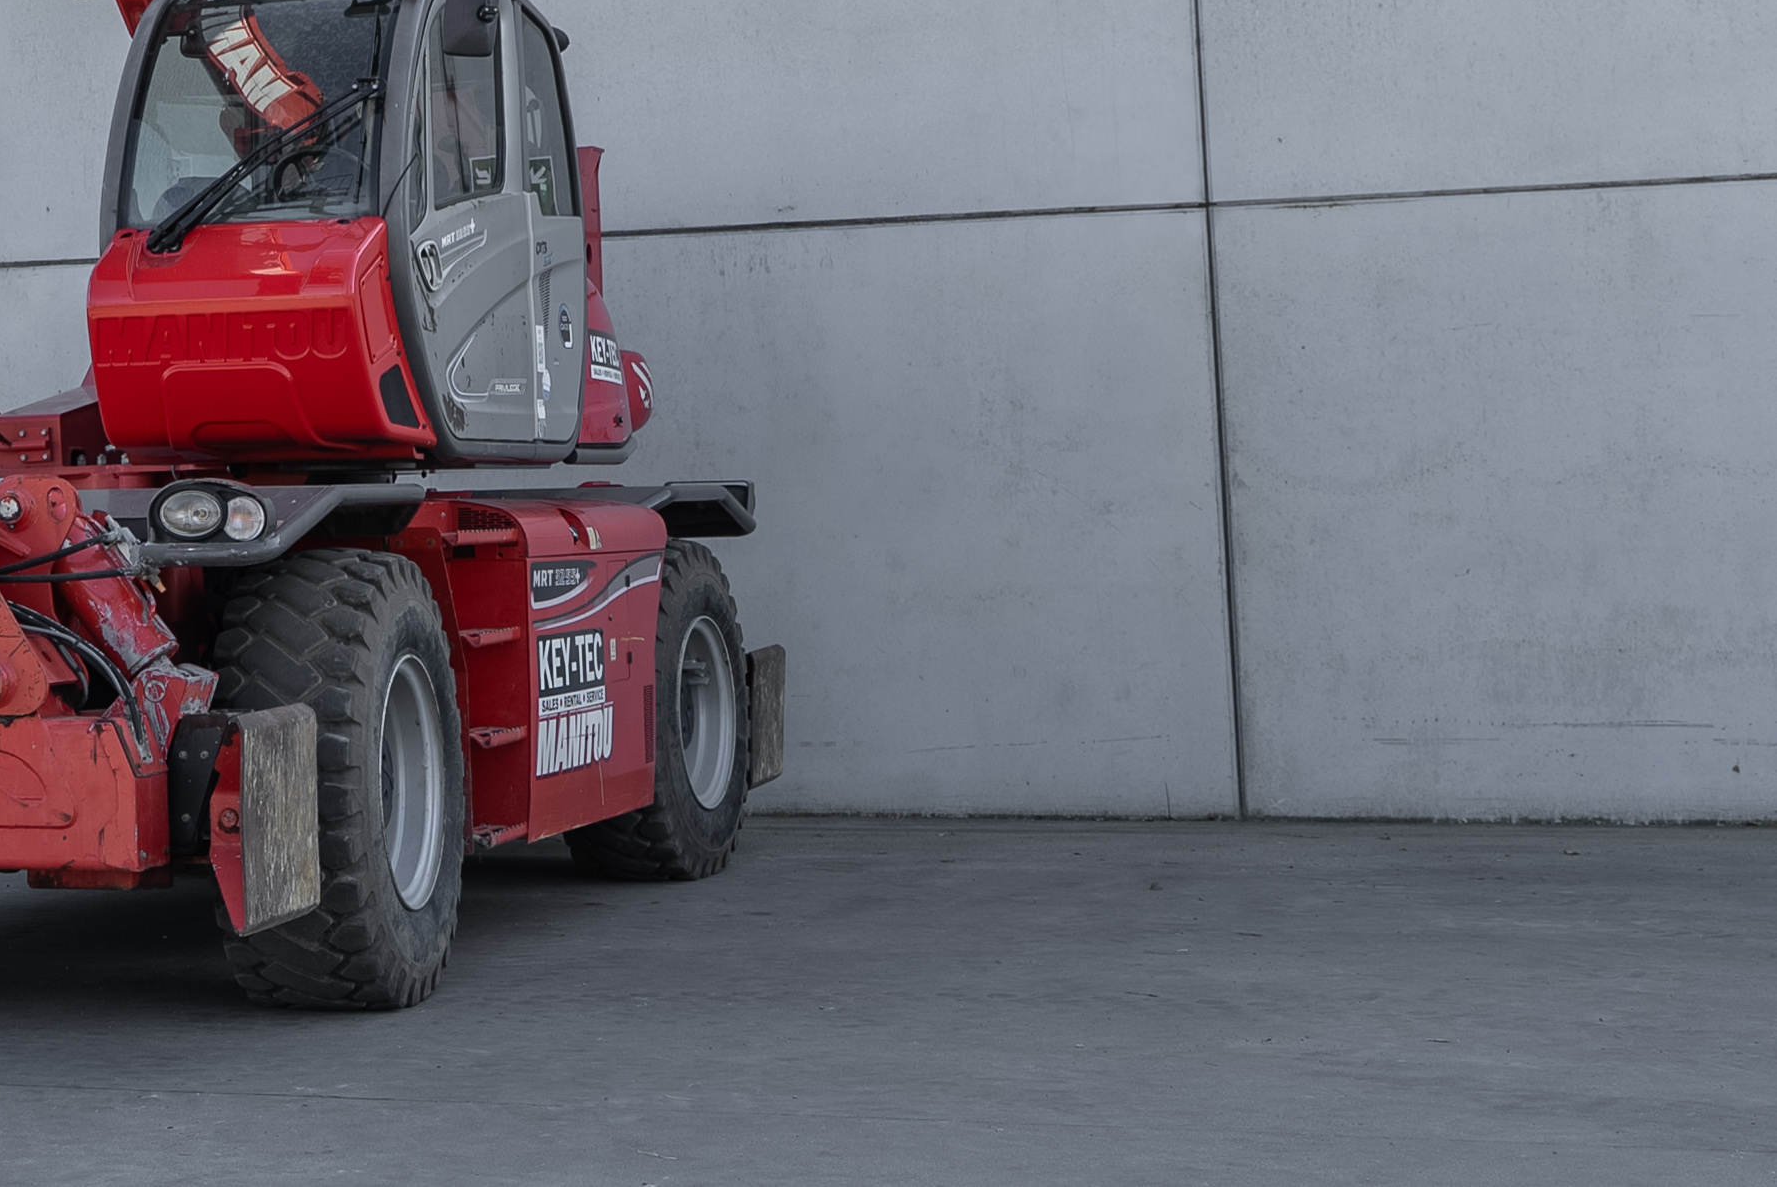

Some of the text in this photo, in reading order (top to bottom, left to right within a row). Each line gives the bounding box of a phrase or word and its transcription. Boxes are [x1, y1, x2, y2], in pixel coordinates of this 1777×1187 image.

[96, 309, 348, 367] MANITOU
[590, 335, 619, 368] KEY-TEC
[533, 569, 553, 588] MRT
[538, 632, 603, 691] KEY-TEC
[541, 688, 604, 712] SALES RENTAL SERVICE
[535, 705, 614, 777] MANITOU
